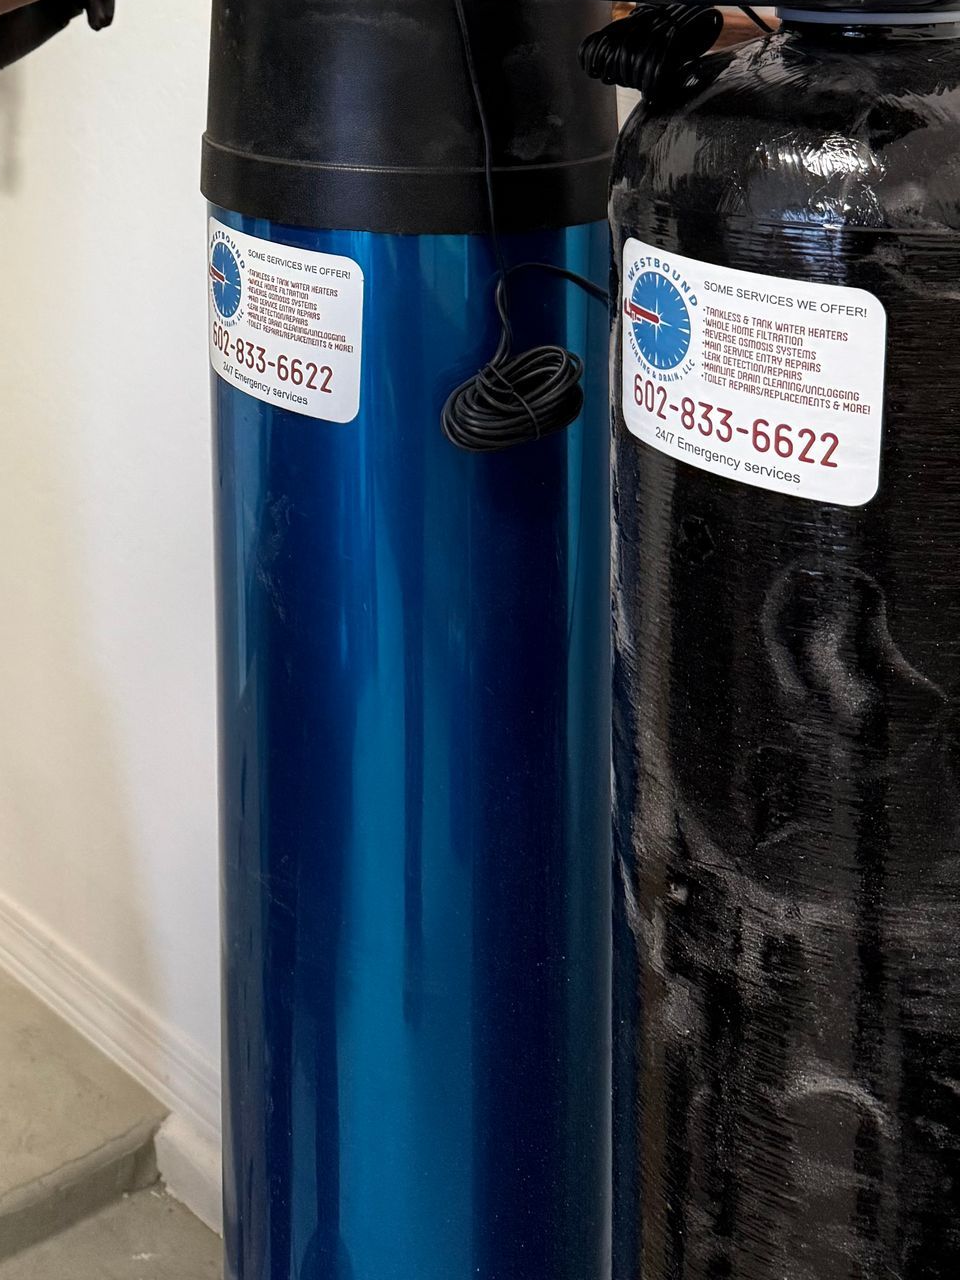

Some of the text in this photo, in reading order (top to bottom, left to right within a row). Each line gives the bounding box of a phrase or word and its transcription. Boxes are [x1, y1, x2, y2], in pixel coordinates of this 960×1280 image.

[627, 256, 698, 307] WESTBOUND
[704, 281, 867, 317] SOME SERVICES WE OFFER!
[731, 324, 754, 338] HOME
[756, 330, 803, 346] FILTRATION
[743, 316, 749, 324] &
[752, 317, 772, 330] TANK
[775, 322, 806, 335] WATER
[808, 328, 848, 341] HEATERS
[212, 320, 334, 394] 602-833-6622
[723, 345, 753, 360] SERVICE
[756, 353, 783, 366] ENTRY
[785, 358, 821, 373] REPAIRS
[738, 337, 774, 353] OSMOSIS
[776, 345, 817, 360] SYSTEMS
[658, 372, 683, 382] DRAIN,
[682, 358, 696, 375] LLC
[723, 356, 802, 381] DETECTION/REPAIRS
[234, 368, 270, 395] Emergency
[272, 388, 308, 406] services
[729, 379, 830, 409] REPAIRS/REPLACEMENTS
[833, 401, 840, 410] &
[843, 402, 871, 415] MORE!
[737, 370, 761, 384] DRAIN
[763, 377, 860, 401] CLEANING/UNCLOGGING
[634, 373, 839, 468] 602-833-6622
[655, 427, 801, 484] 24/7 Emergency services
